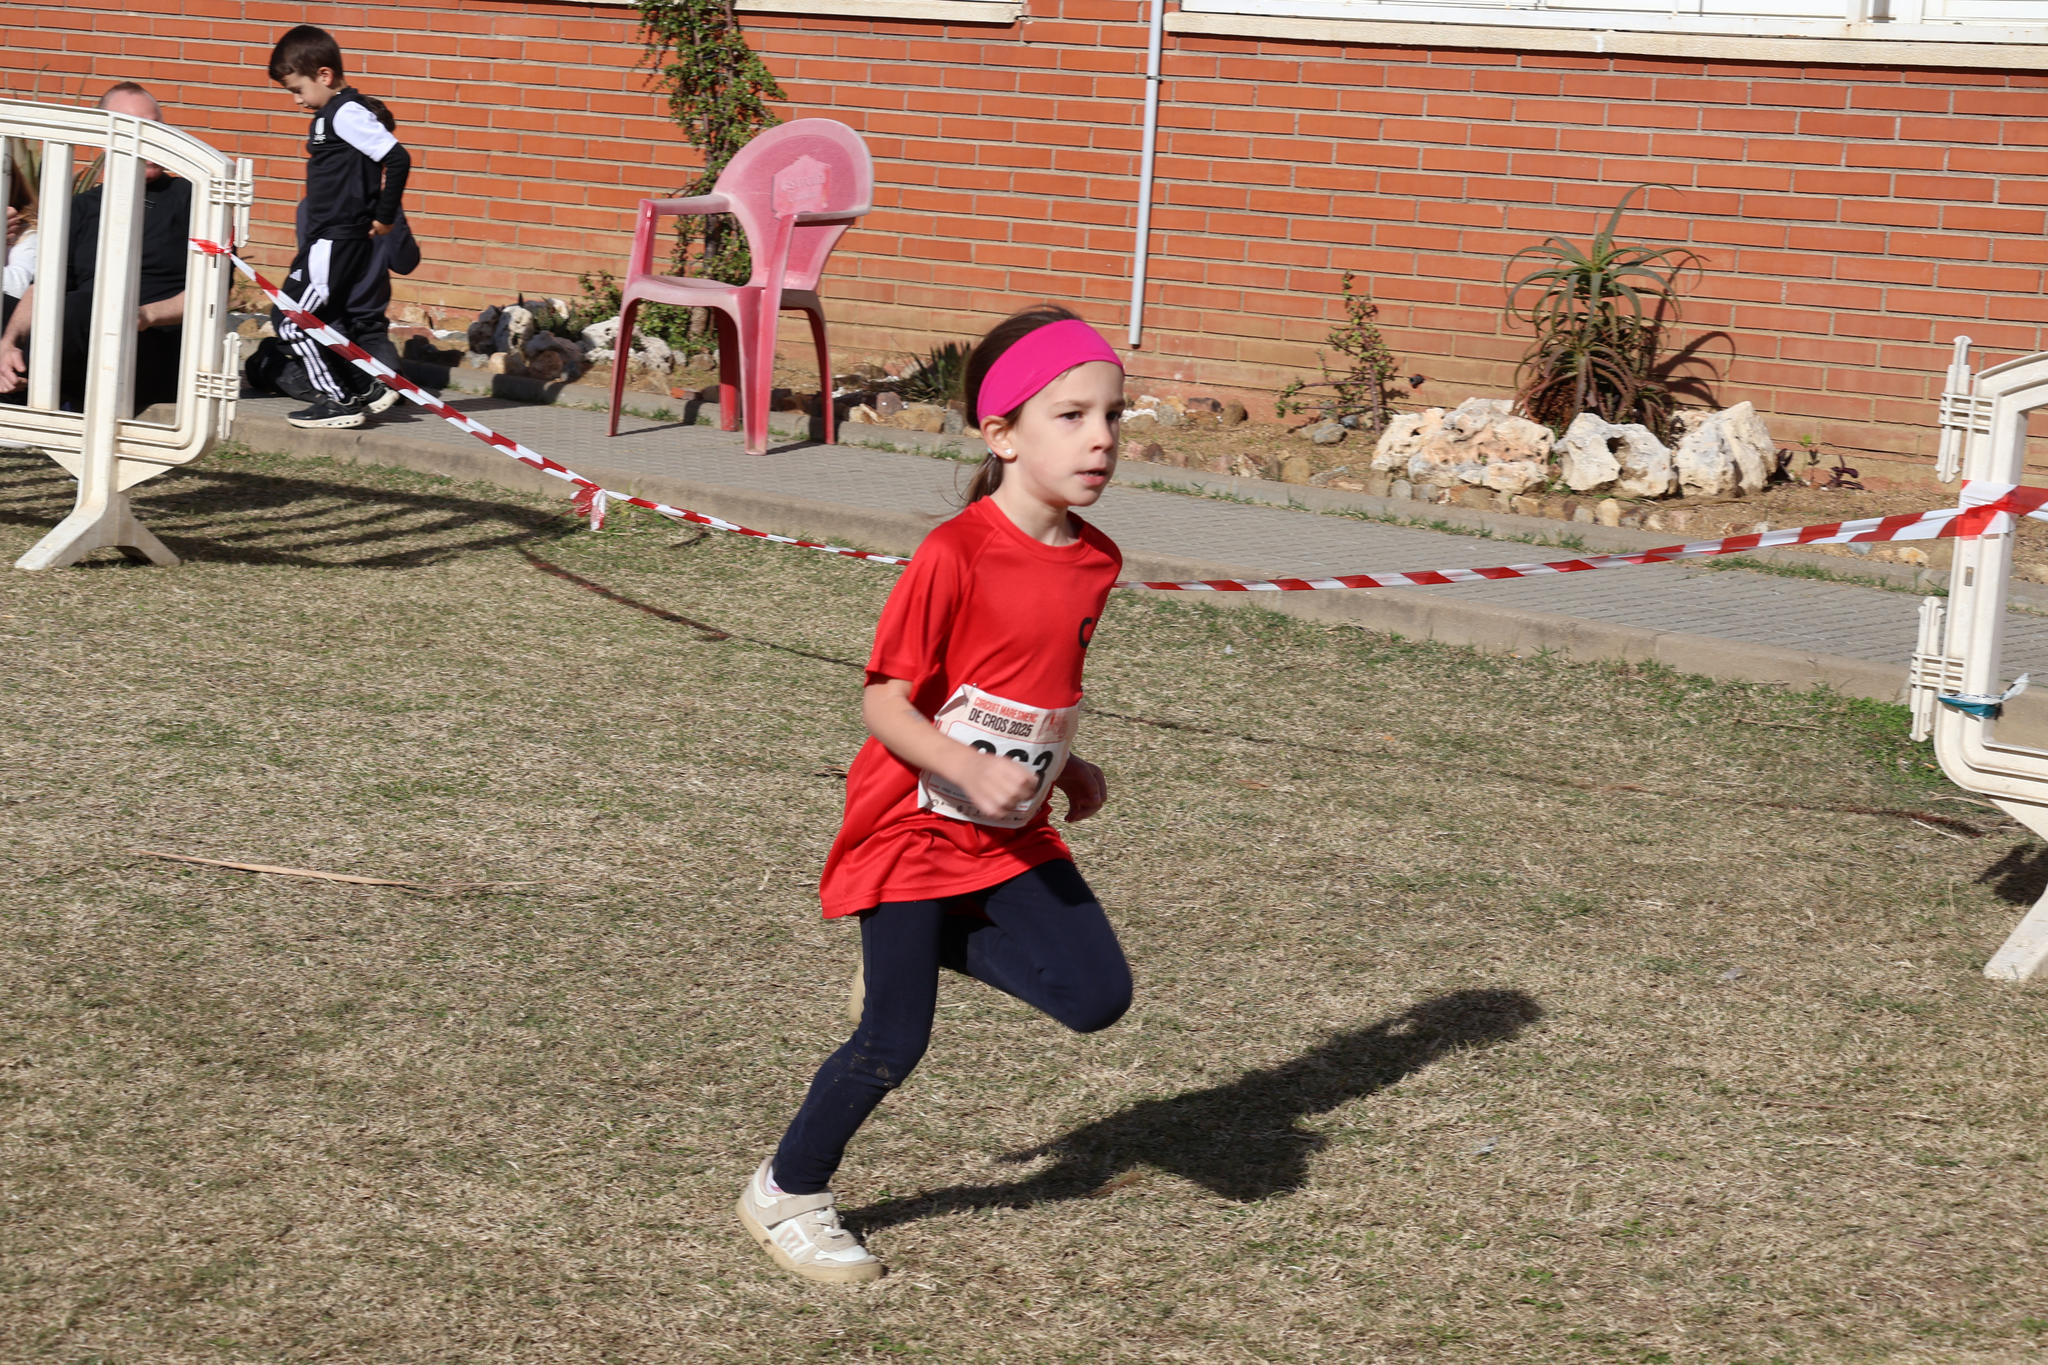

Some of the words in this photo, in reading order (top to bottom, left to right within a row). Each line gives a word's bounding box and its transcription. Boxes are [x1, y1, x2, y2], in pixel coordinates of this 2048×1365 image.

[968, 708, 984, 724] DE
[982, 713, 1009, 733] CROS
[1007, 721, 1034, 738] 2025
